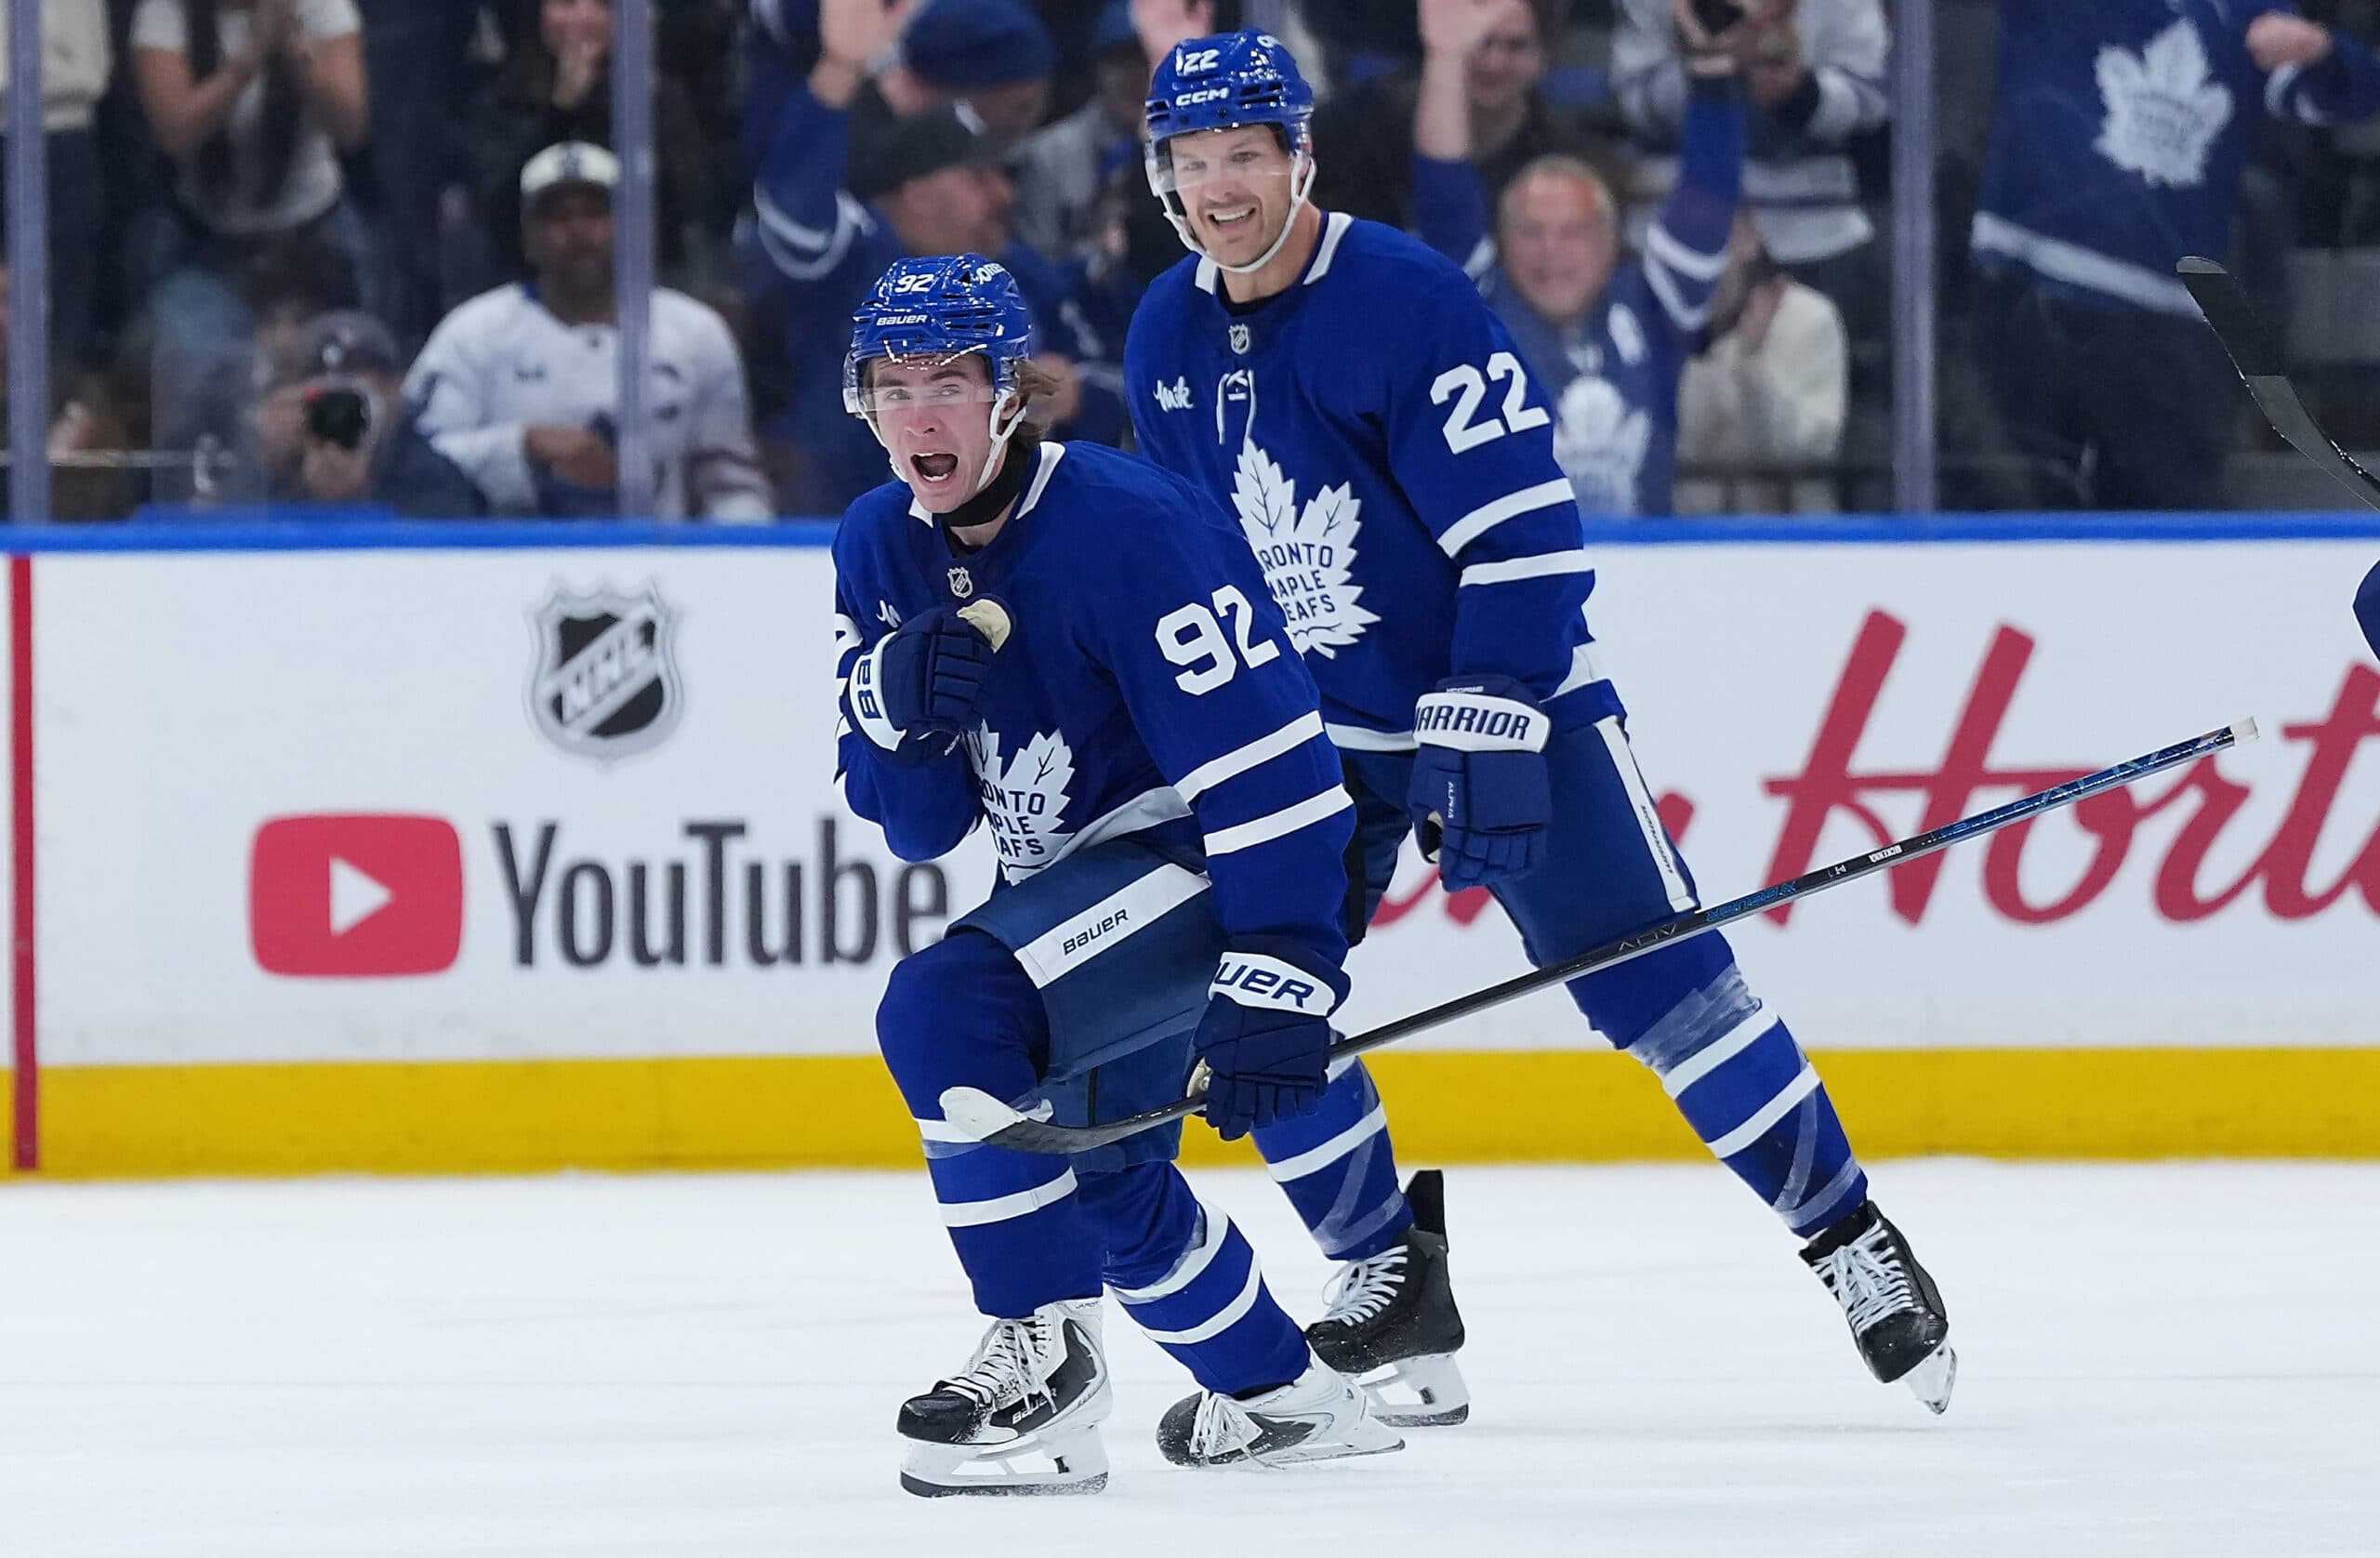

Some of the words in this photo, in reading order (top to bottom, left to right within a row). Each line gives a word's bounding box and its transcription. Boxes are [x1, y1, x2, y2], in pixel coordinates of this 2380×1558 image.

[1183, 49, 1221, 75] 22
[1175, 87, 1229, 107] CCM
[894, 273, 934, 293] 92
[1430, 351, 1551, 456] 22
[1259, 542, 1334, 572] RONTO
[1284, 594, 1336, 622] EAFS
[1155, 585, 1281, 696] 92
[1761, 608, 2380, 928] Hort
[982, 779, 1046, 815] ONTO
[991, 812, 1035, 835] PLE
[998, 837, 1045, 858] AFS
[489, 815, 949, 968] YouTube
[1212, 960, 1316, 1009] UER
